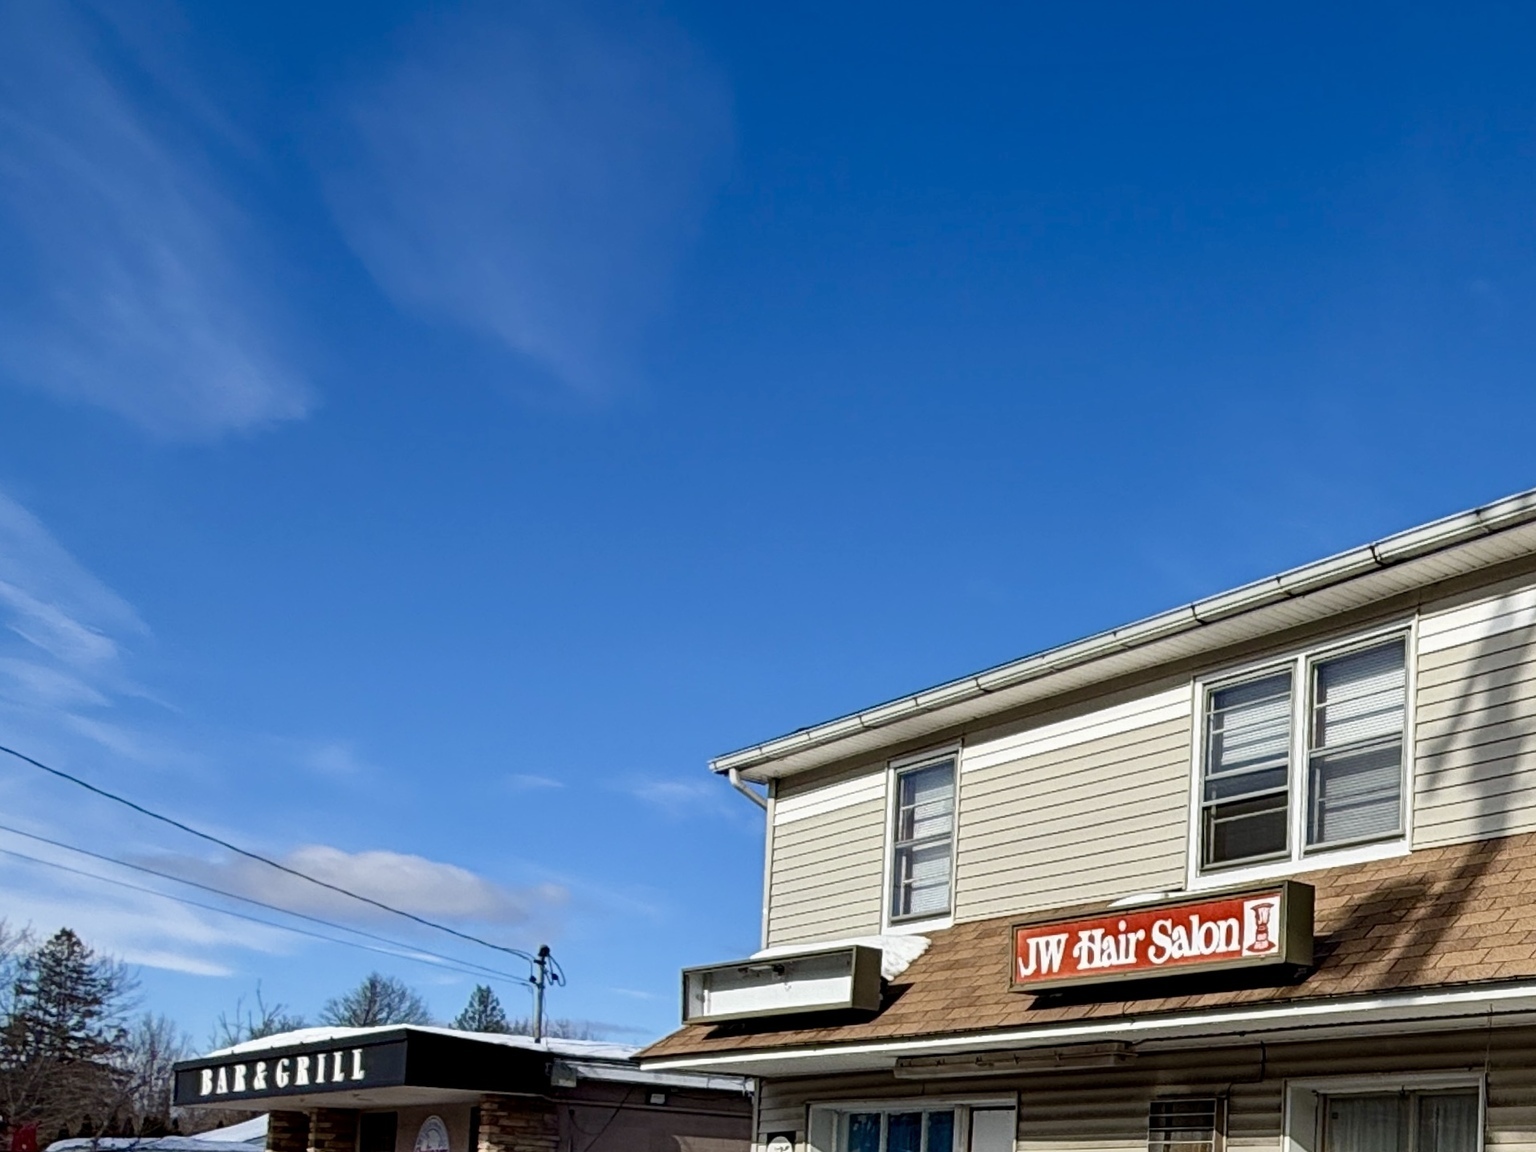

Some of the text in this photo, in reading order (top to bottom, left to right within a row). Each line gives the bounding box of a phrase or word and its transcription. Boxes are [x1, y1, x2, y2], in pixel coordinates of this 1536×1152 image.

[1018, 914, 1241, 978] JW Hair Salon
[200, 1048, 365, 1096] BAR & GRILL
